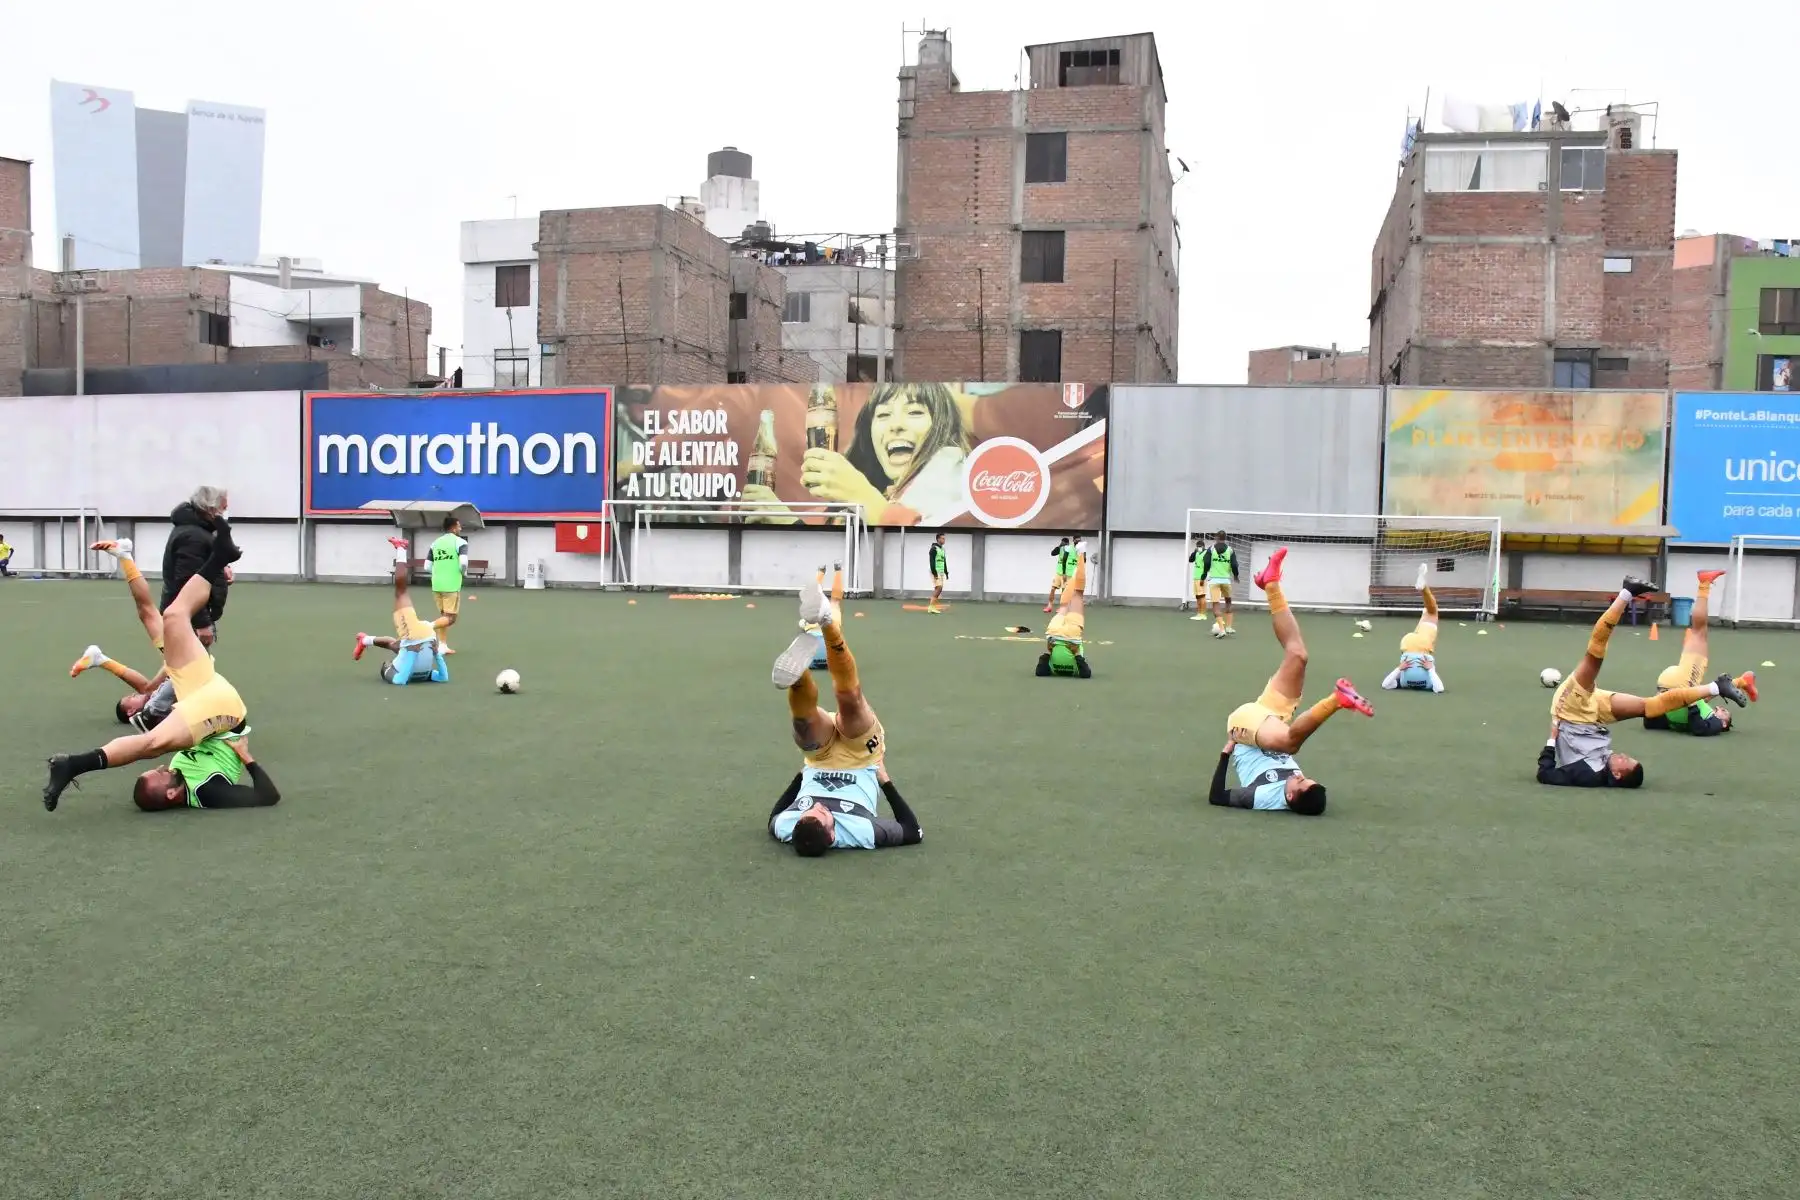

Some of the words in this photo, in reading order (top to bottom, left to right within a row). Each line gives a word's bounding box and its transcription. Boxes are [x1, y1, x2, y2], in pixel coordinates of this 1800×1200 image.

[643, 409, 664, 434] EL
[667, 409, 728, 434] SABOR
[318, 422, 597, 475] marathon
[1411, 429, 1474, 447] PLAN
[632, 441, 656, 465] DE
[658, 441, 739, 465] ALENTAR
[1725, 450, 1800, 482] unic
[626, 472, 640, 497] A
[643, 472, 666, 497] TU
[669, 472, 741, 500] EQUIPO.
[1722, 504, 1756, 518] para
[1758, 503, 1793, 518] cada
